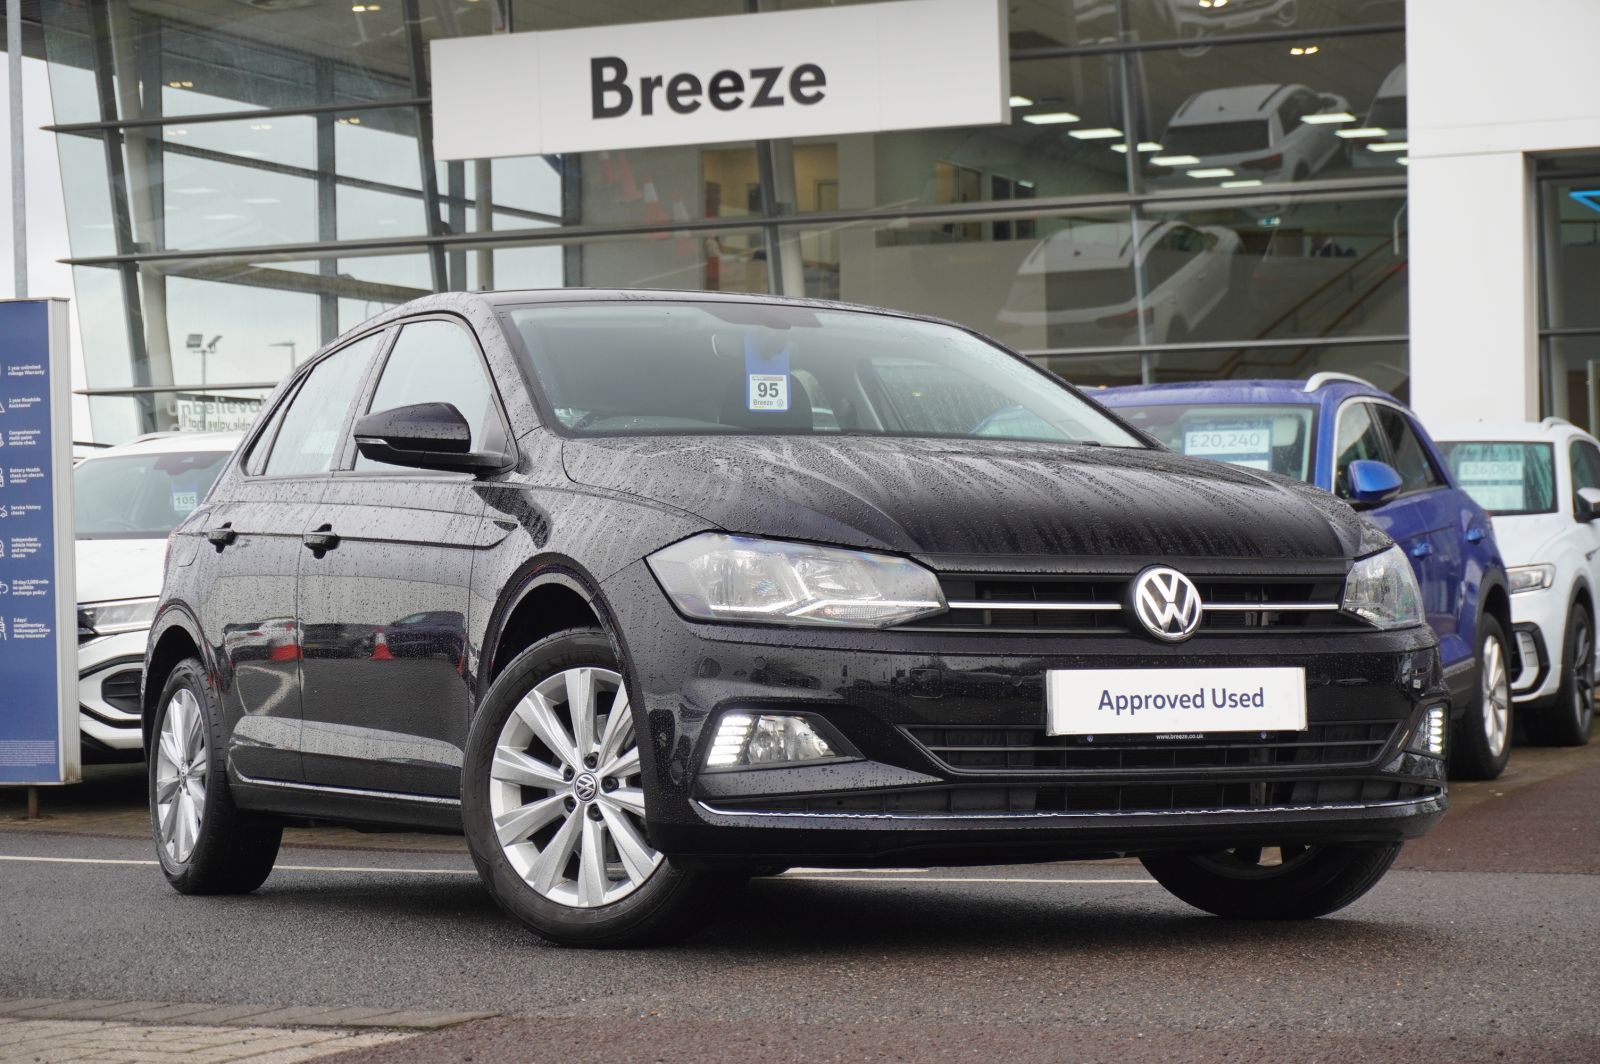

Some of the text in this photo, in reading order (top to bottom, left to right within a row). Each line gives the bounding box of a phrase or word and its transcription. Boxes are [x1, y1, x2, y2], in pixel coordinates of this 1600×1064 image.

[590, 55, 827, 120] Breeze
[757, 382, 779, 398] 95
[1190, 432, 1261, 448] £20,240
[175, 496, 196, 505] 105
[1098, 686, 1264, 715] Approved Used
